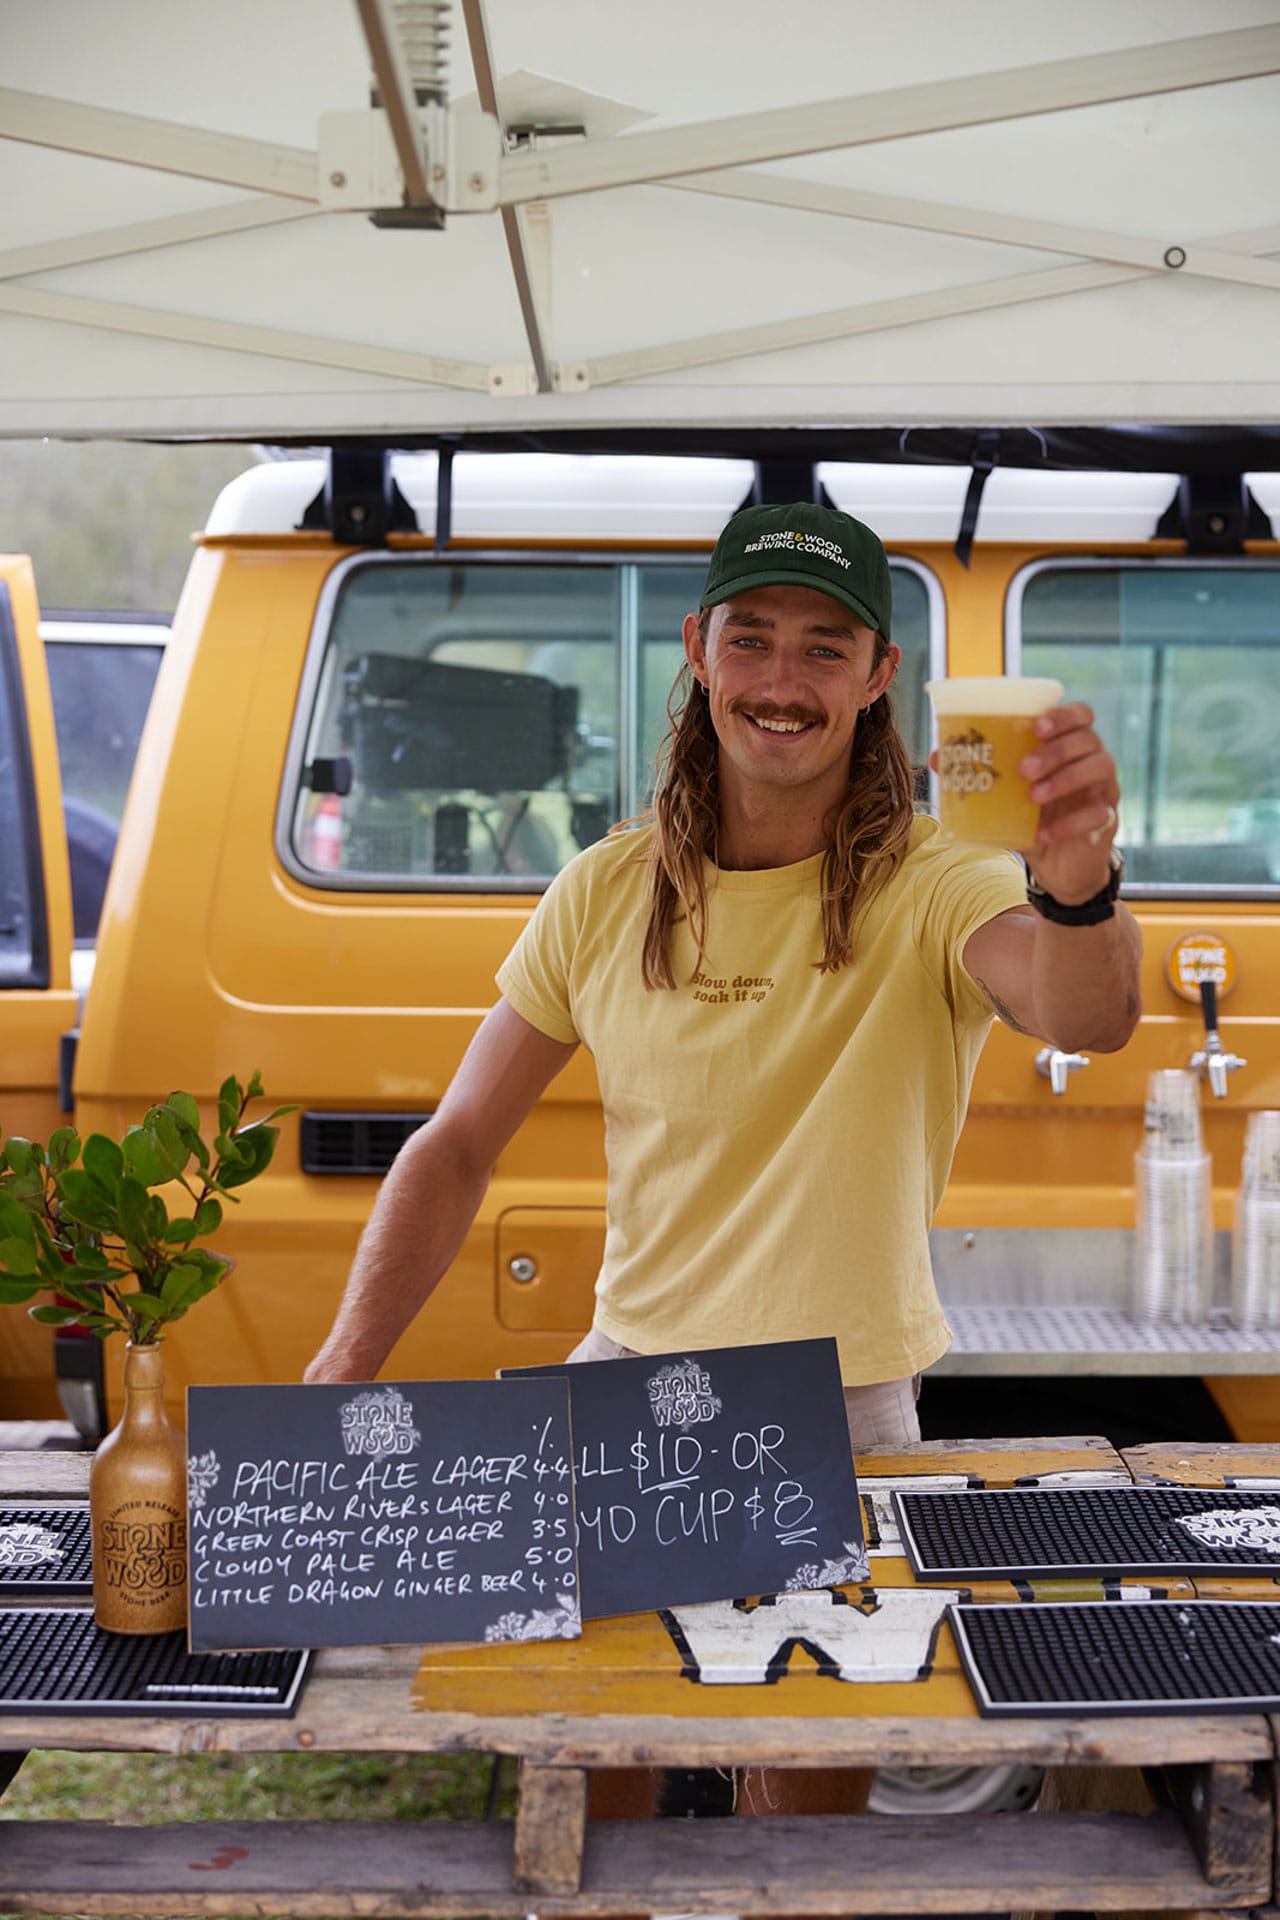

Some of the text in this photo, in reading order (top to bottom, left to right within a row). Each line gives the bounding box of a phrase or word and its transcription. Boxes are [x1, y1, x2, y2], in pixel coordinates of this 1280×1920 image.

[744, 540, 852, 569] BREWING COMPANY
[693, 990, 766, 1004] soak it up
[647, 1372, 712, 1402] STONE
[341, 1402, 413, 1428] STONE
[651, 1399, 714, 1427] WOOD
[342, 1430, 414, 1455] WOOD
[572, 1441, 624, 1486] LL
[732, 1424, 787, 1475] OR
[233, 1454, 570, 1500] PACIFIC ALE LAGER 4.4
[193, 1491, 569, 1529] NORTHERN RIVERS LAGER 4.0
[575, 1505, 636, 1551] YO
[655, 1488, 734, 1545] CUP
[101, 1519, 188, 1552] STONE
[194, 1518, 567, 1559] GREEN COAST CRISP LAGER 3.5
[103, 1555, 187, 1590] WOOD
[195, 1546, 572, 1583] CLOUDY PALE ALE 5.0
[194, 1569, 577, 1608] LITTLE DRAGON GINGER BEER 4.0
